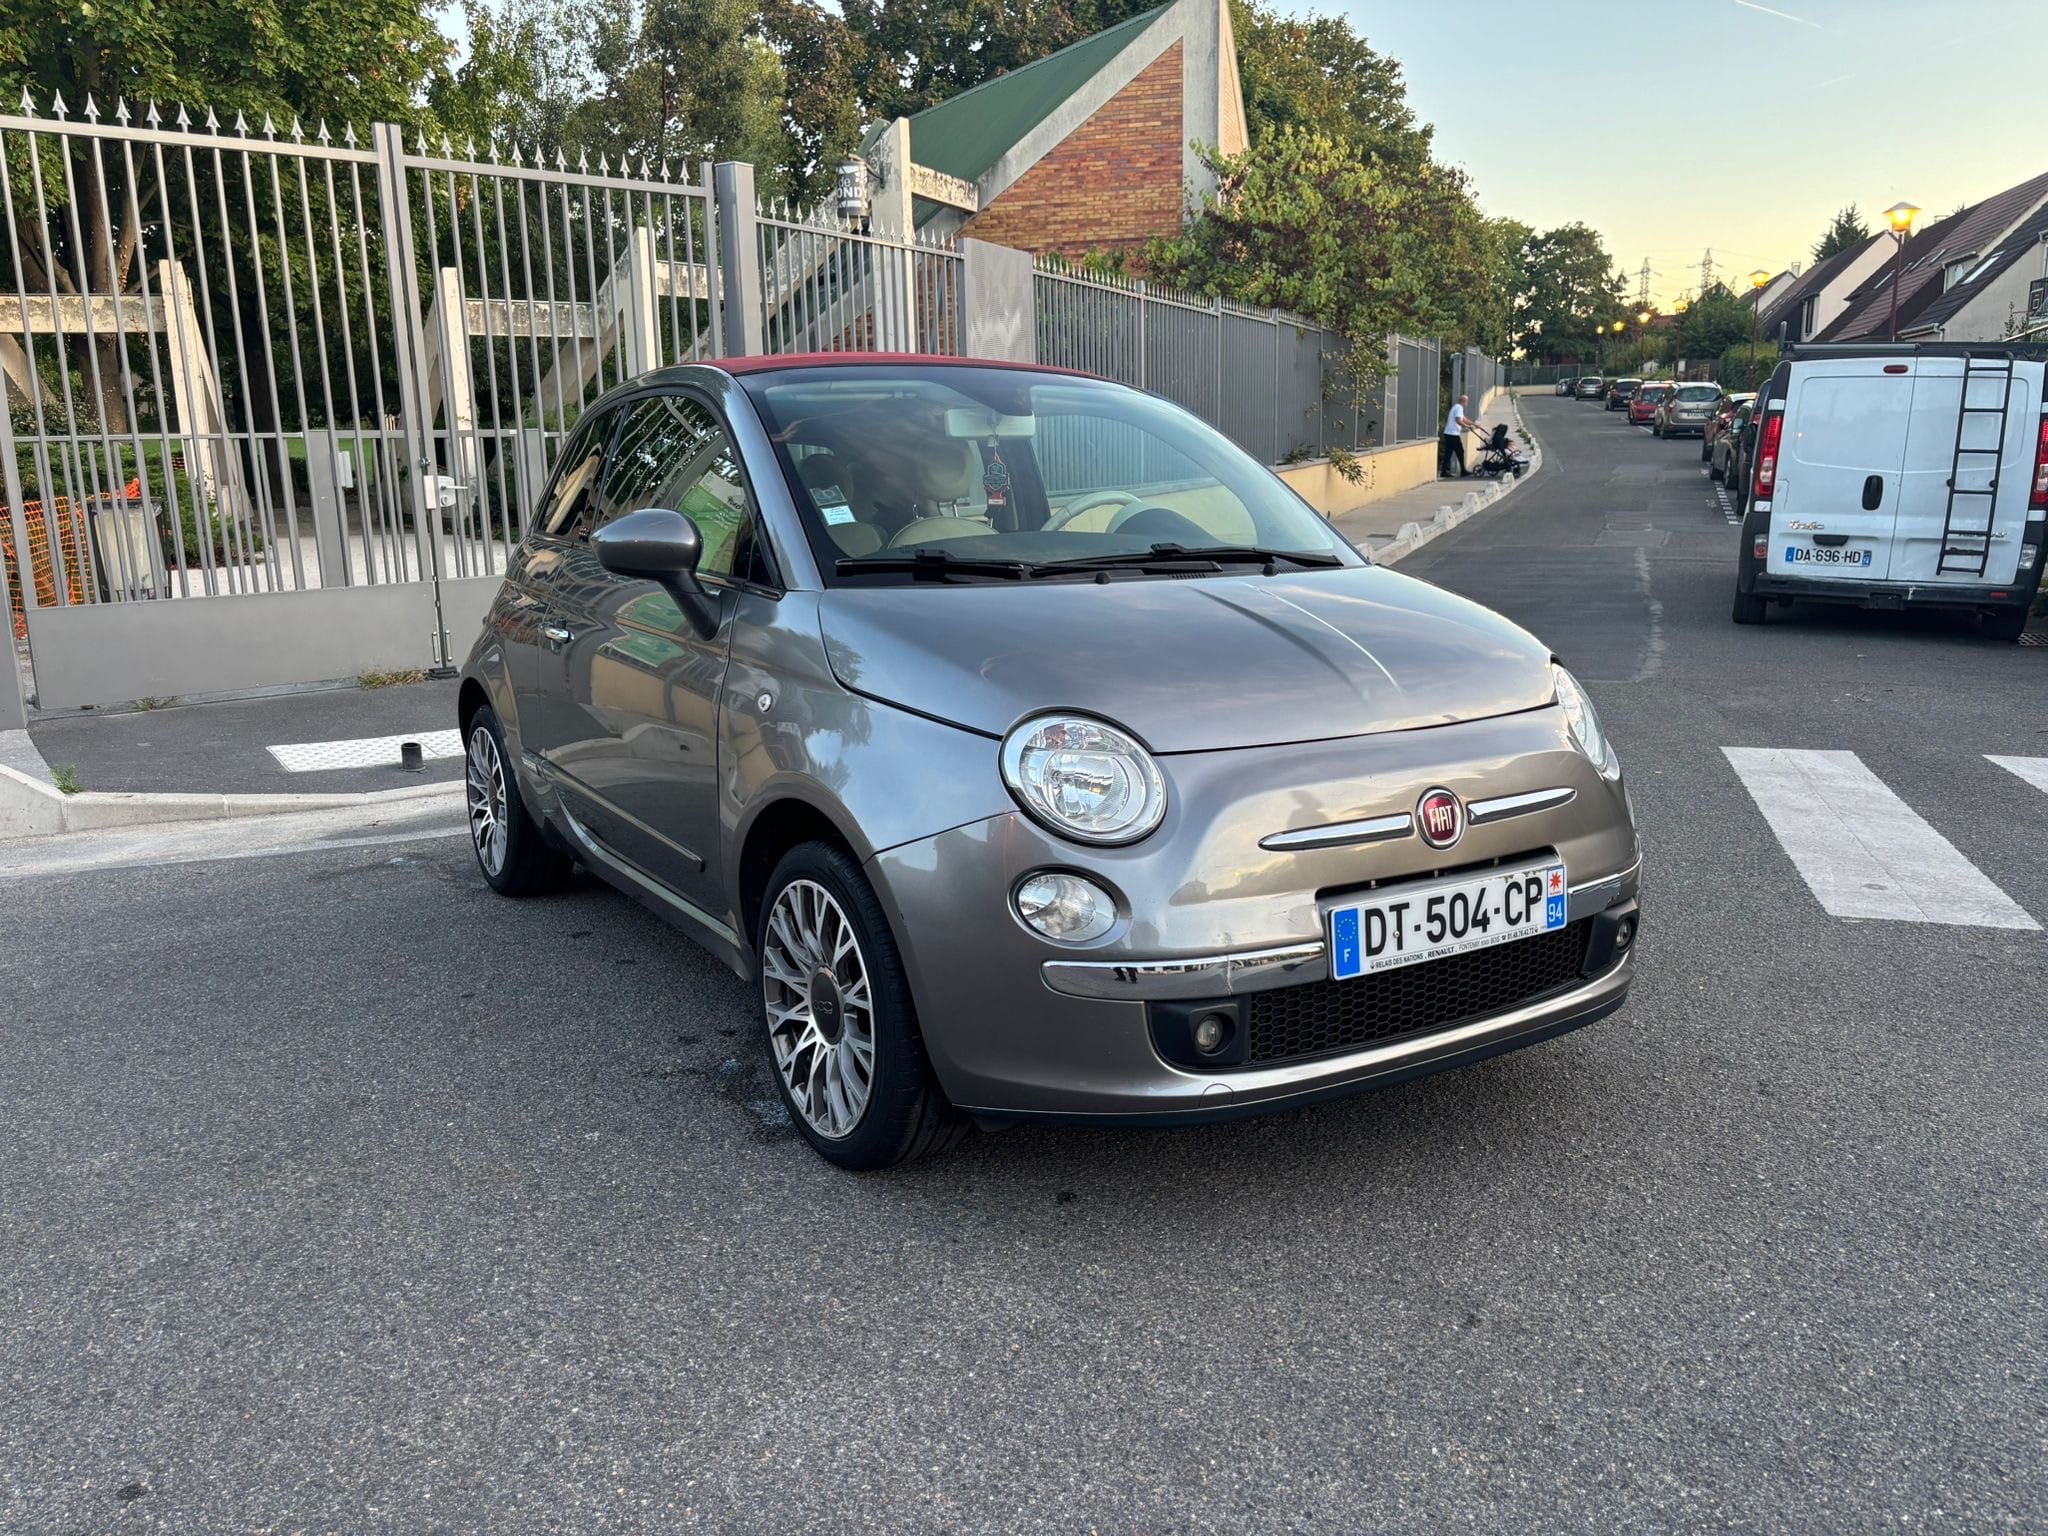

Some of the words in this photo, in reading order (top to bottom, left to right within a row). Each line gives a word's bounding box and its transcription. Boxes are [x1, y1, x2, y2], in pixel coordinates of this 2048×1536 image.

[838, 176, 851, 187] de
[1795, 548, 1861, 563] DA-696-HD
[1428, 805, 1453, 833] FIAT
[1364, 876, 1543, 957] DT-504-CP
[1548, 901, 1563, 922] 94
[1344, 947, 1351, 963] F
